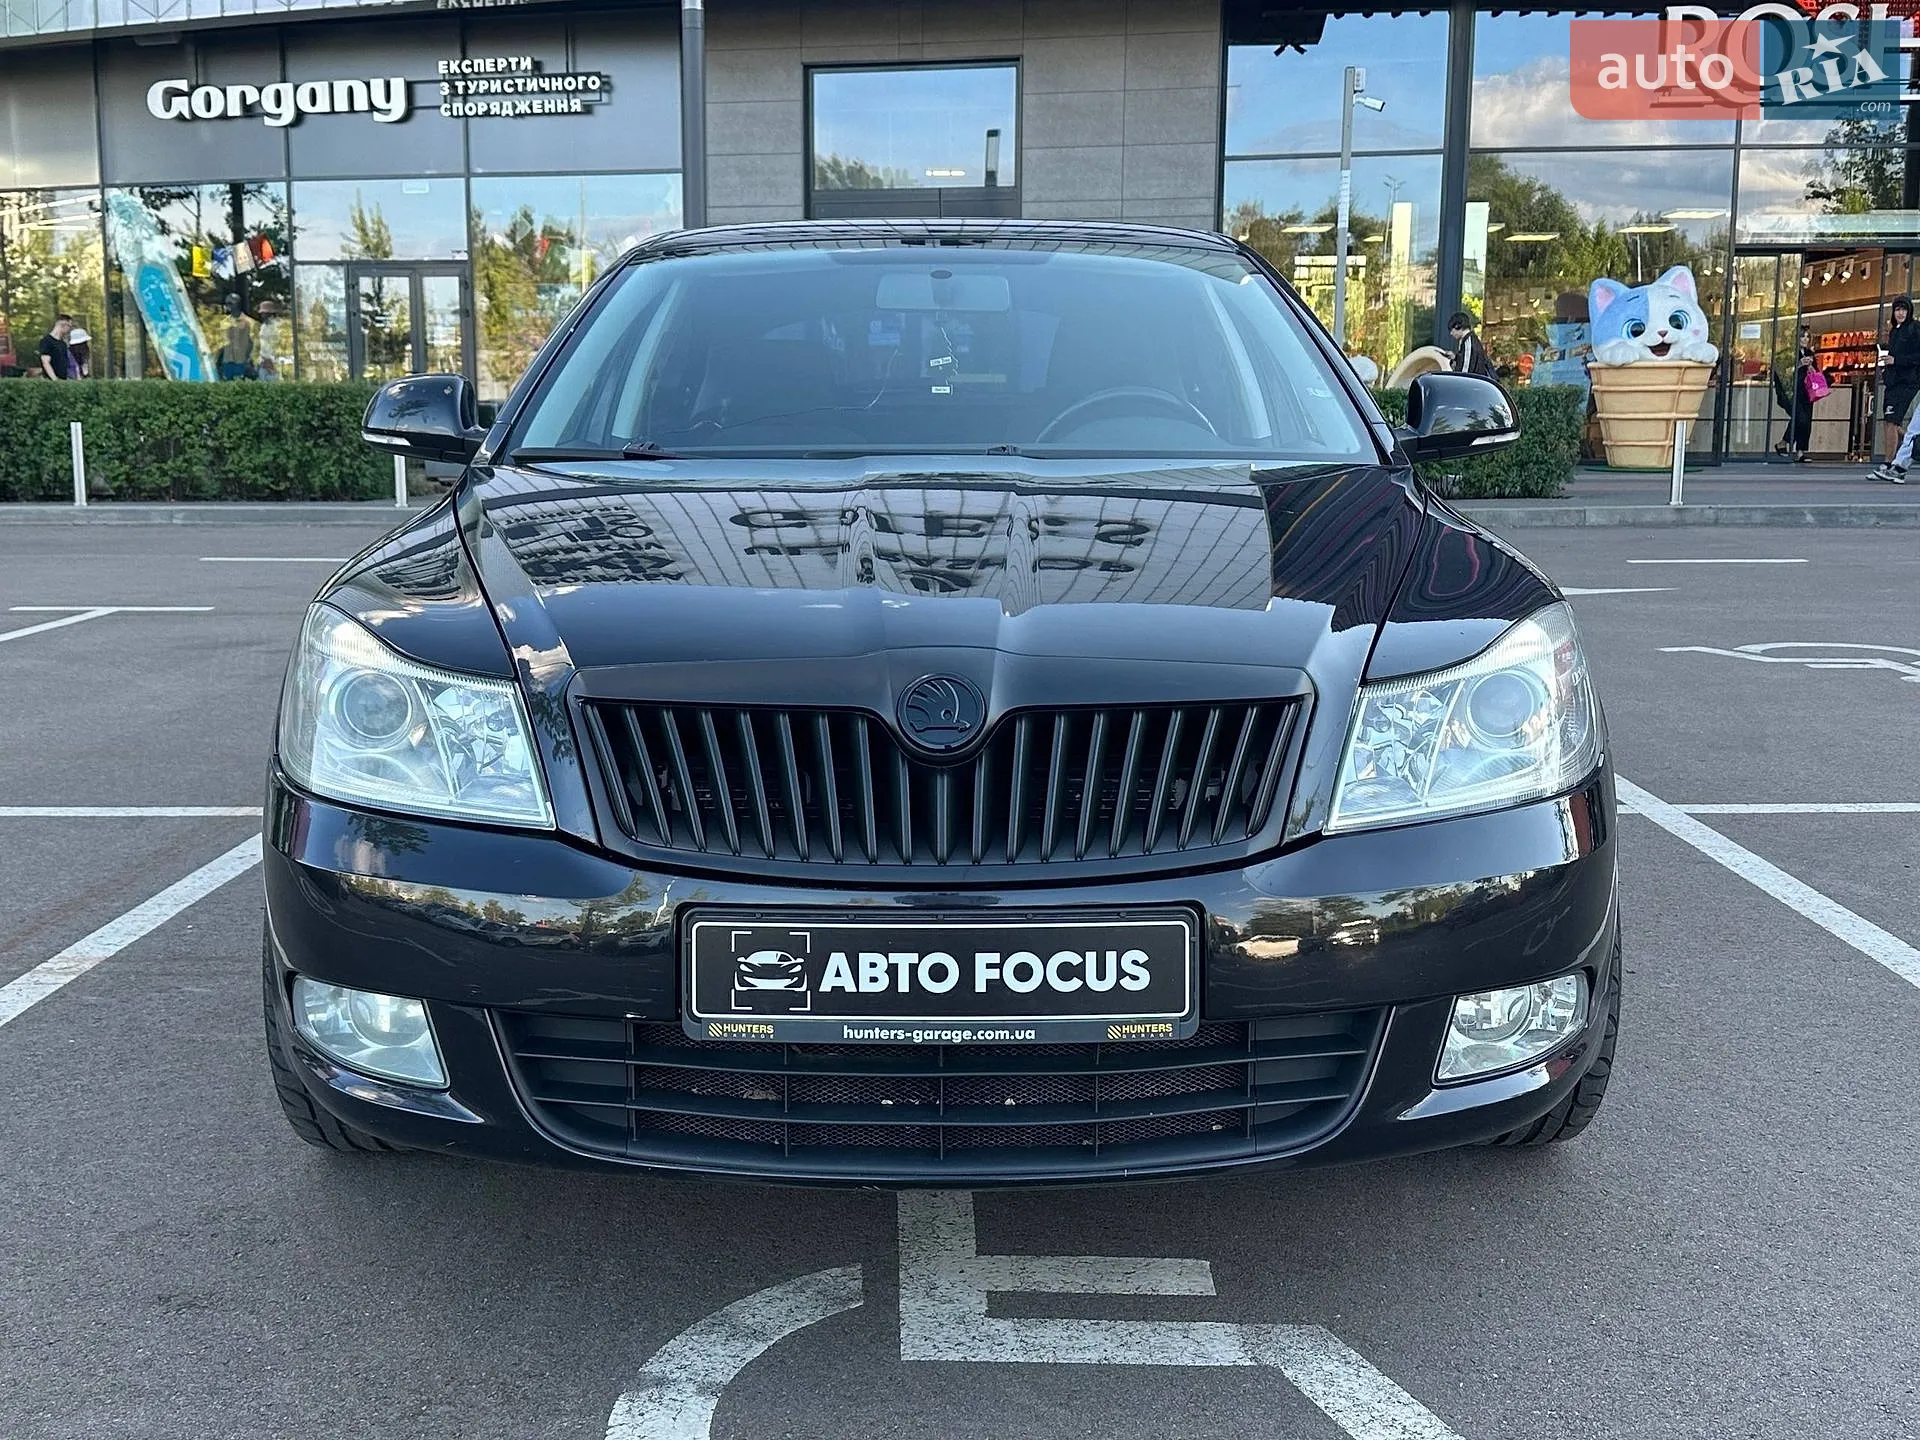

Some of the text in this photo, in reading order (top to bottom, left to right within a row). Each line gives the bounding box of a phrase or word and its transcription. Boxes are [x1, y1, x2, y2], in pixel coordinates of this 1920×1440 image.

[438, 56, 532, 74] ЕКСПЕРТИ
[439, 76, 600, 95] З ТУРИСТИЧНОГО
[147, 77, 405, 127] Gorgany
[440, 98, 582, 117] СПОРЯДЖЕННЯ
[818, 949, 1151, 994] АВТО FOCUS
[723, 1023, 774, 1034] HUNTERS
[843, 1025, 1036, 1043] hunters-garage.com.ua
[1122, 1023, 1173, 1034] HUNTERS
